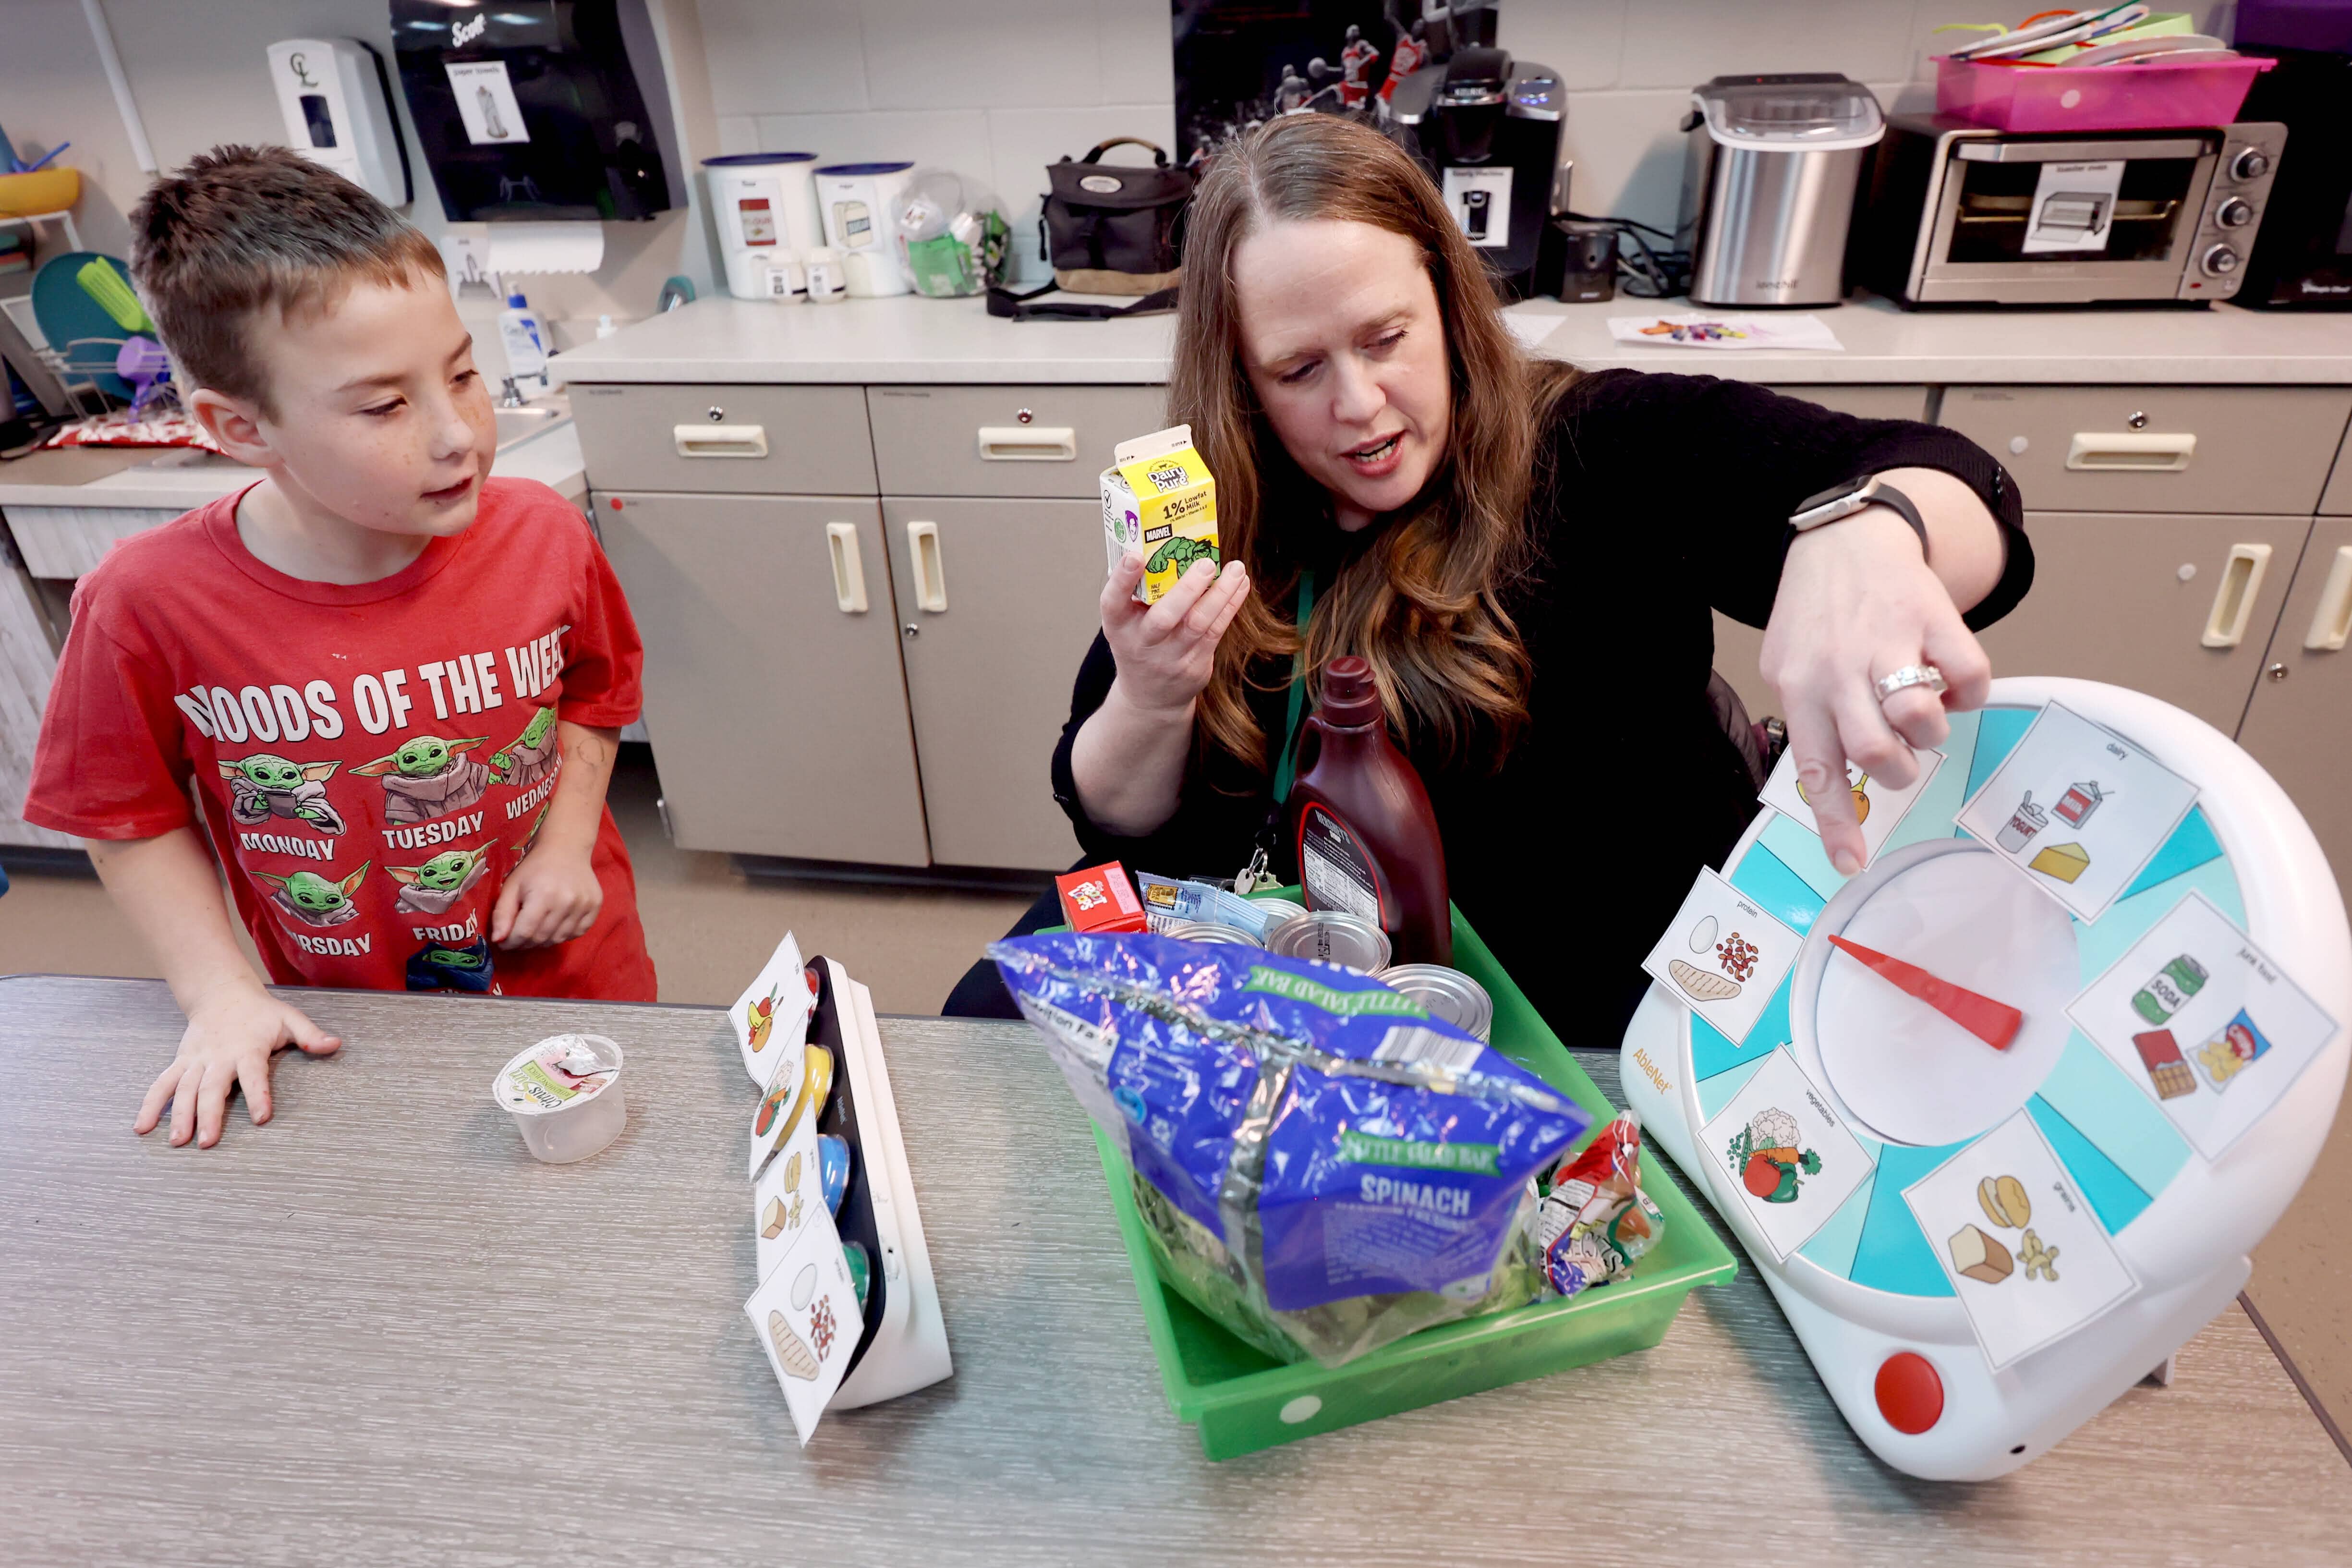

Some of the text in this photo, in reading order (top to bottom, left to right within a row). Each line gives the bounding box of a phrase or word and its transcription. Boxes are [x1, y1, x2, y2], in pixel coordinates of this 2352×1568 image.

[452, 13, 486, 47] Scott
[1147, 466, 1187, 483] Dairy
[1155, 475, 1188, 493] Pure
[1163, 499, 1185, 519] 1%
[1185, 491, 1207, 504] Lowfat
[1187, 501, 1200, 511] Milk
[1146, 526, 1171, 542] MARVEL
[352, 669, 412, 735] OF
[418, 651, 503, 720] THE
[2106, 743, 2128, 761] dairy
[240, 833, 335, 861] MONDAY
[382, 811, 484, 849] TUESDAY
[2010, 816, 2037, 838] YOGURT
[1304, 845, 1321, 861] Nutrition
[1736, 901, 1758, 918] protein
[294, 933, 371, 957] RSDAY
[1254, 966, 1292, 993] BAR
[1293, 979, 1350, 1014] SALAD
[2152, 979, 2181, 1007] SODA
[508, 1069, 530, 1093] Sun
[527, 1067, 542, 1082] JUICE
[1633, 1047, 1670, 1095] AbleNet
[529, 1086, 562, 1109] Citrus
[542, 1077, 572, 1097] REFRESHING
[1806, 1089, 1835, 1127] vegetables
[1407, 1142, 1456, 1167] SALAD
[1459, 1145, 1493, 1171] BAR
[1360, 1173, 1471, 1217] SPINACH
